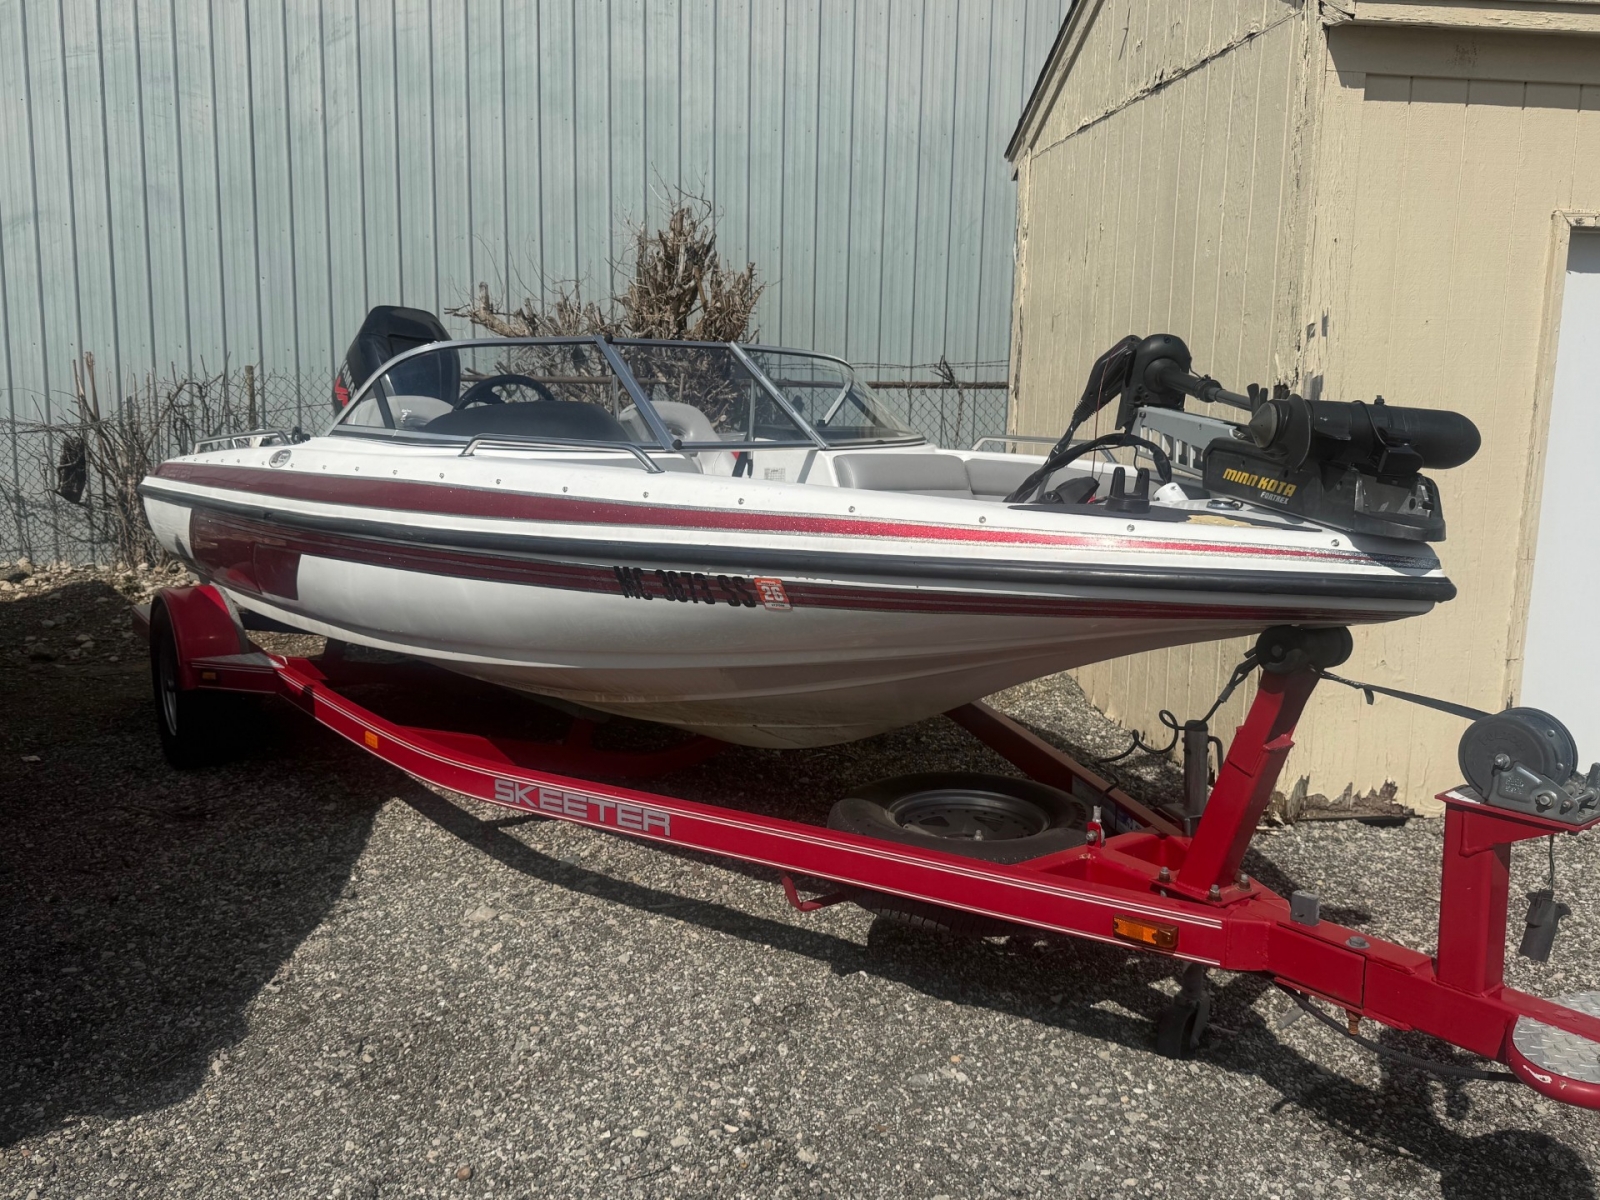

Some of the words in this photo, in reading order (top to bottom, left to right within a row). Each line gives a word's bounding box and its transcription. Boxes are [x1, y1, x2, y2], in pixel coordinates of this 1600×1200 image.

[1257, 476, 1297, 497] KOTA
[1260, 491, 1289, 505] FORTREX
[613, 566, 653, 600] MC
[717, 575, 756, 607] SS
[761, 585, 784, 601] 26
[494, 779, 671, 836] SKEETER
